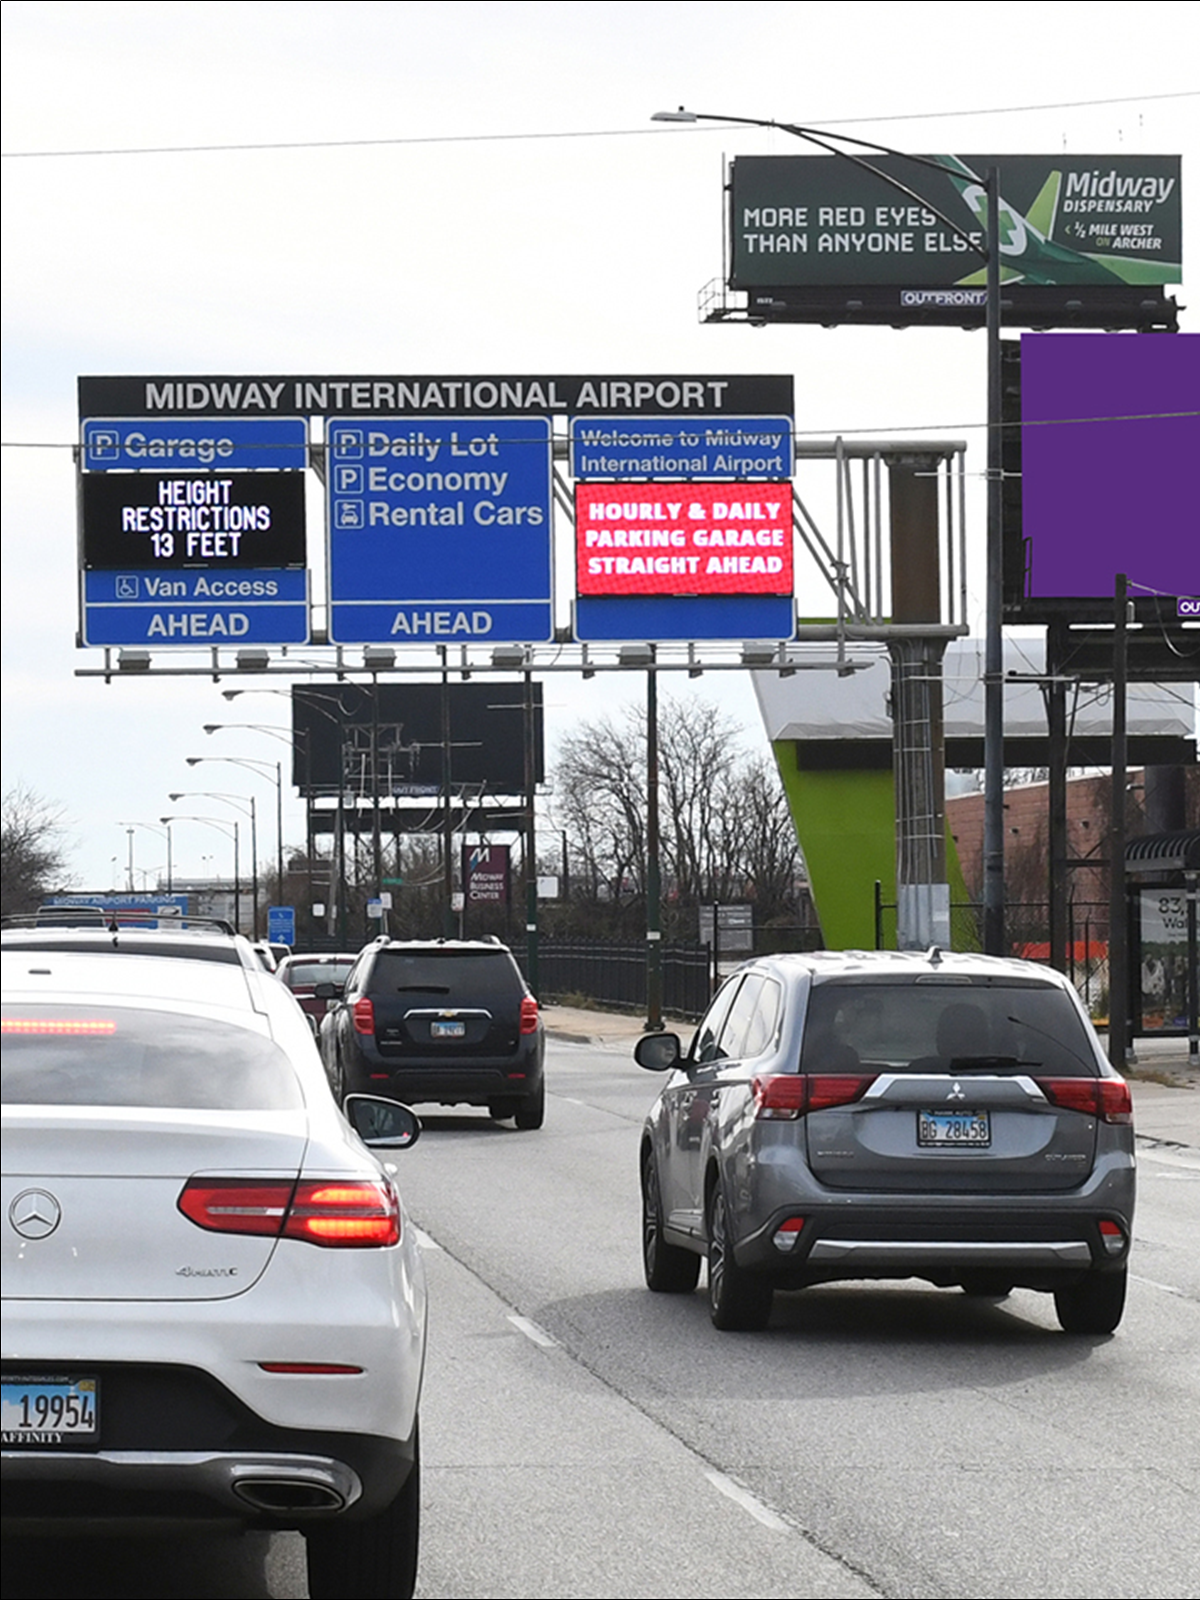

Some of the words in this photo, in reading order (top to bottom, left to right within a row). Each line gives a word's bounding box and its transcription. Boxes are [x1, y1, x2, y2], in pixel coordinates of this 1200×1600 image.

[1065, 170, 1175, 203] Midway
[1063, 199, 1153, 213] DISPENSARY
[743, 207, 808, 227] MORE
[818, 207, 865, 226] RED
[875, 207, 937, 226] EYES
[1088, 224, 1118, 236] MILE
[1120, 224, 1154, 236] WEST
[743, 233, 808, 253] THAN
[818, 232, 914, 252] ANYONE
[924, 231, 983, 252] ELSE
[1111, 237, 1162, 250] ARCHER
[904, 290, 985, 305] OUTFRONT
[145, 382, 285, 410] MIDWAY
[294, 381, 568, 409] INTERNATIONAL
[576, 381, 728, 408] AIRPORT
[124, 432, 235, 463] Garage
[368, 431, 441, 462] Daily
[451, 432, 500, 457] Lot
[581, 429, 674, 447] Welcome
[680, 431, 699, 447] to
[705, 429, 783, 449] Midway
[581, 455, 707, 473] International
[713, 455, 783, 475] Airport
[368, 466, 508, 496] Economy
[158, 480, 233, 505] HEIGHT
[121, 506, 270, 532] RESTRICTIONS
[368, 501, 464, 526] Rental
[473, 500, 544, 526] Cars
[588, 502, 682, 521] HOURLY
[687, 503, 706, 520] &
[712, 502, 781, 520] DAILY
[151, 533, 174, 557] 13
[187, 532, 241, 557] FEET
[585, 530, 685, 548] PARKING
[692, 529, 784, 547] GARAGE
[587, 557, 700, 575] STRAIGHT
[705, 556, 783, 574] AHEAD
[144, 578, 187, 597] Van
[193, 577, 278, 597] Access
[147, 613, 250, 637] AHEAD
[390, 612, 493, 635] AHEAD
[921, 1120, 938, 1139] BG
[945, 1120, 987, 1139] 28458
[18, 1394, 94, 1429] 19954
[1, 1432, 62, 1443] AFFINITY
